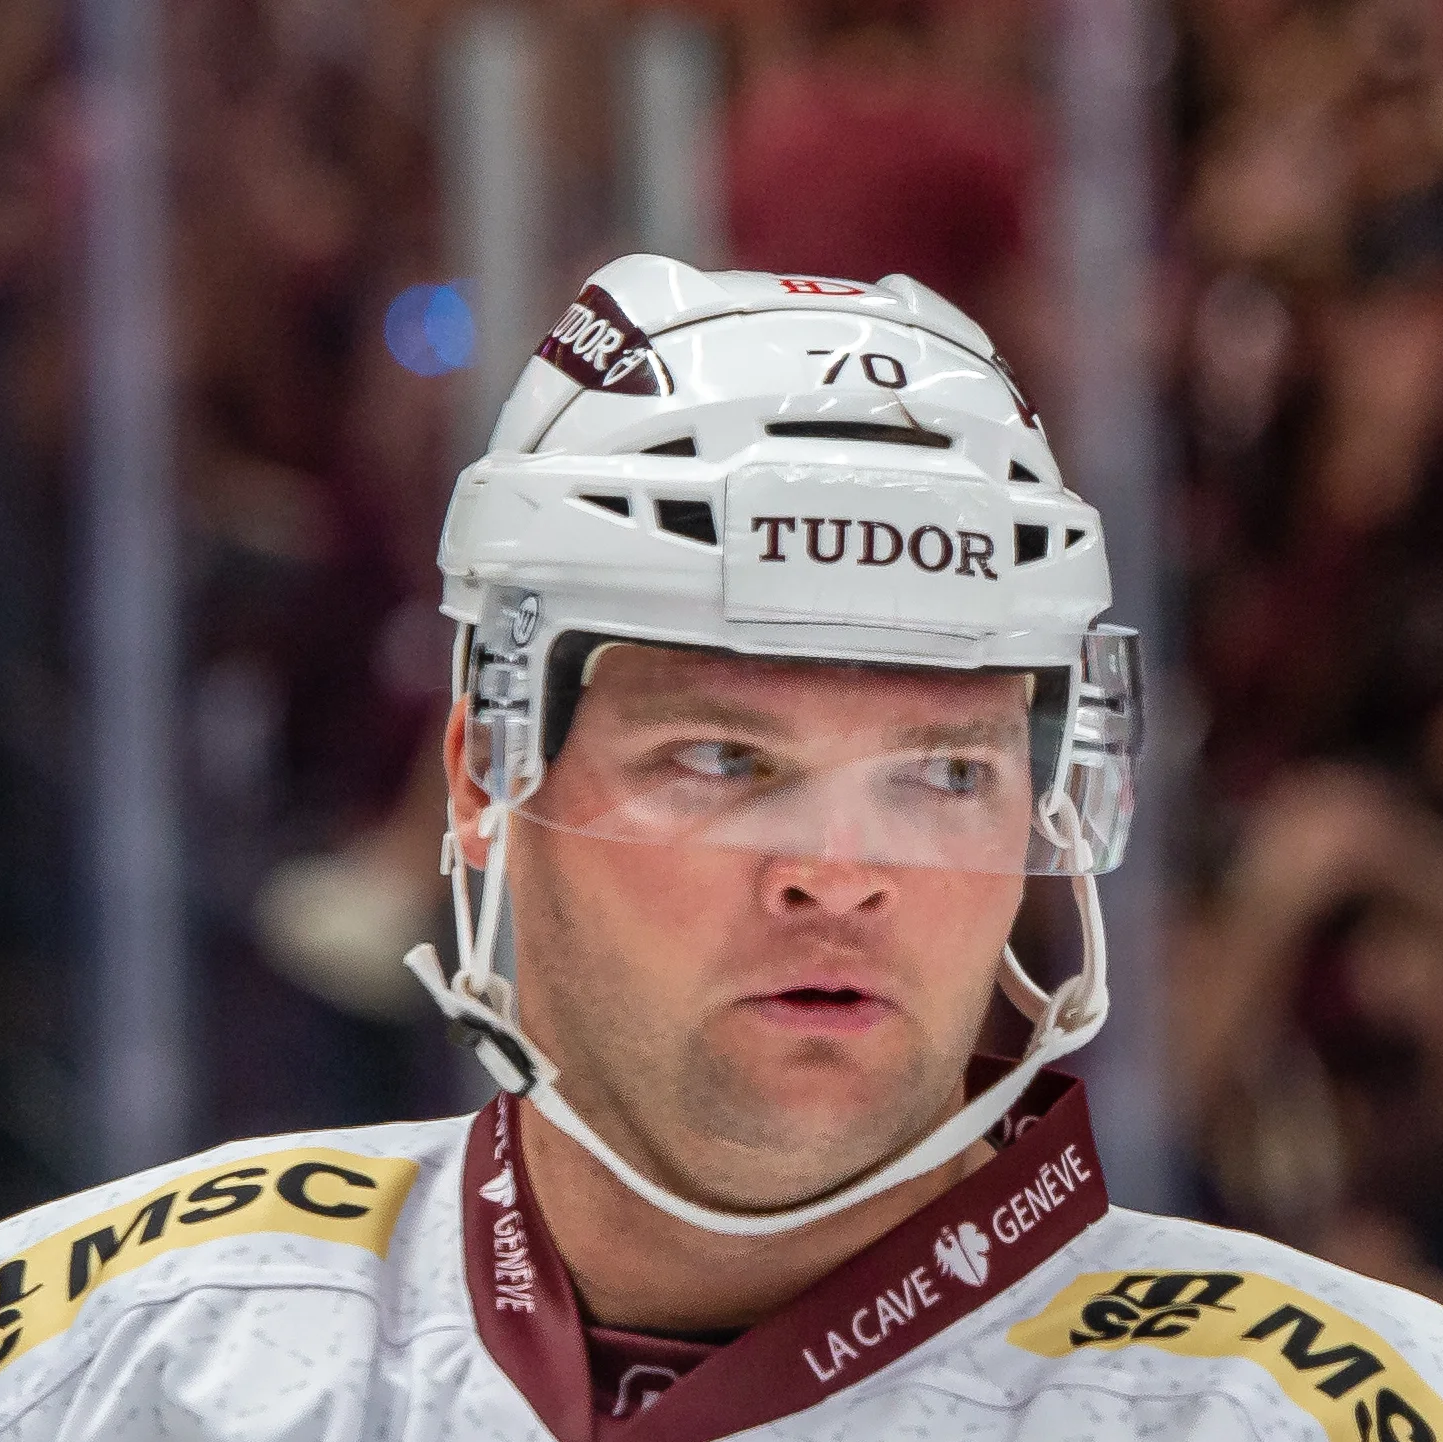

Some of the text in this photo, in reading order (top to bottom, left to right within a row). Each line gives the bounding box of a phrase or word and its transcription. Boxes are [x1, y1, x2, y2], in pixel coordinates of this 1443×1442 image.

[551, 302, 625, 372] UDOR
[806, 347, 908, 389] 70
[750, 515, 998, 581] TUDOR
[67, 1160, 380, 1302] MSC
[801, 1330, 861, 1383] LA
[851, 1265, 941, 1347] CAVE
